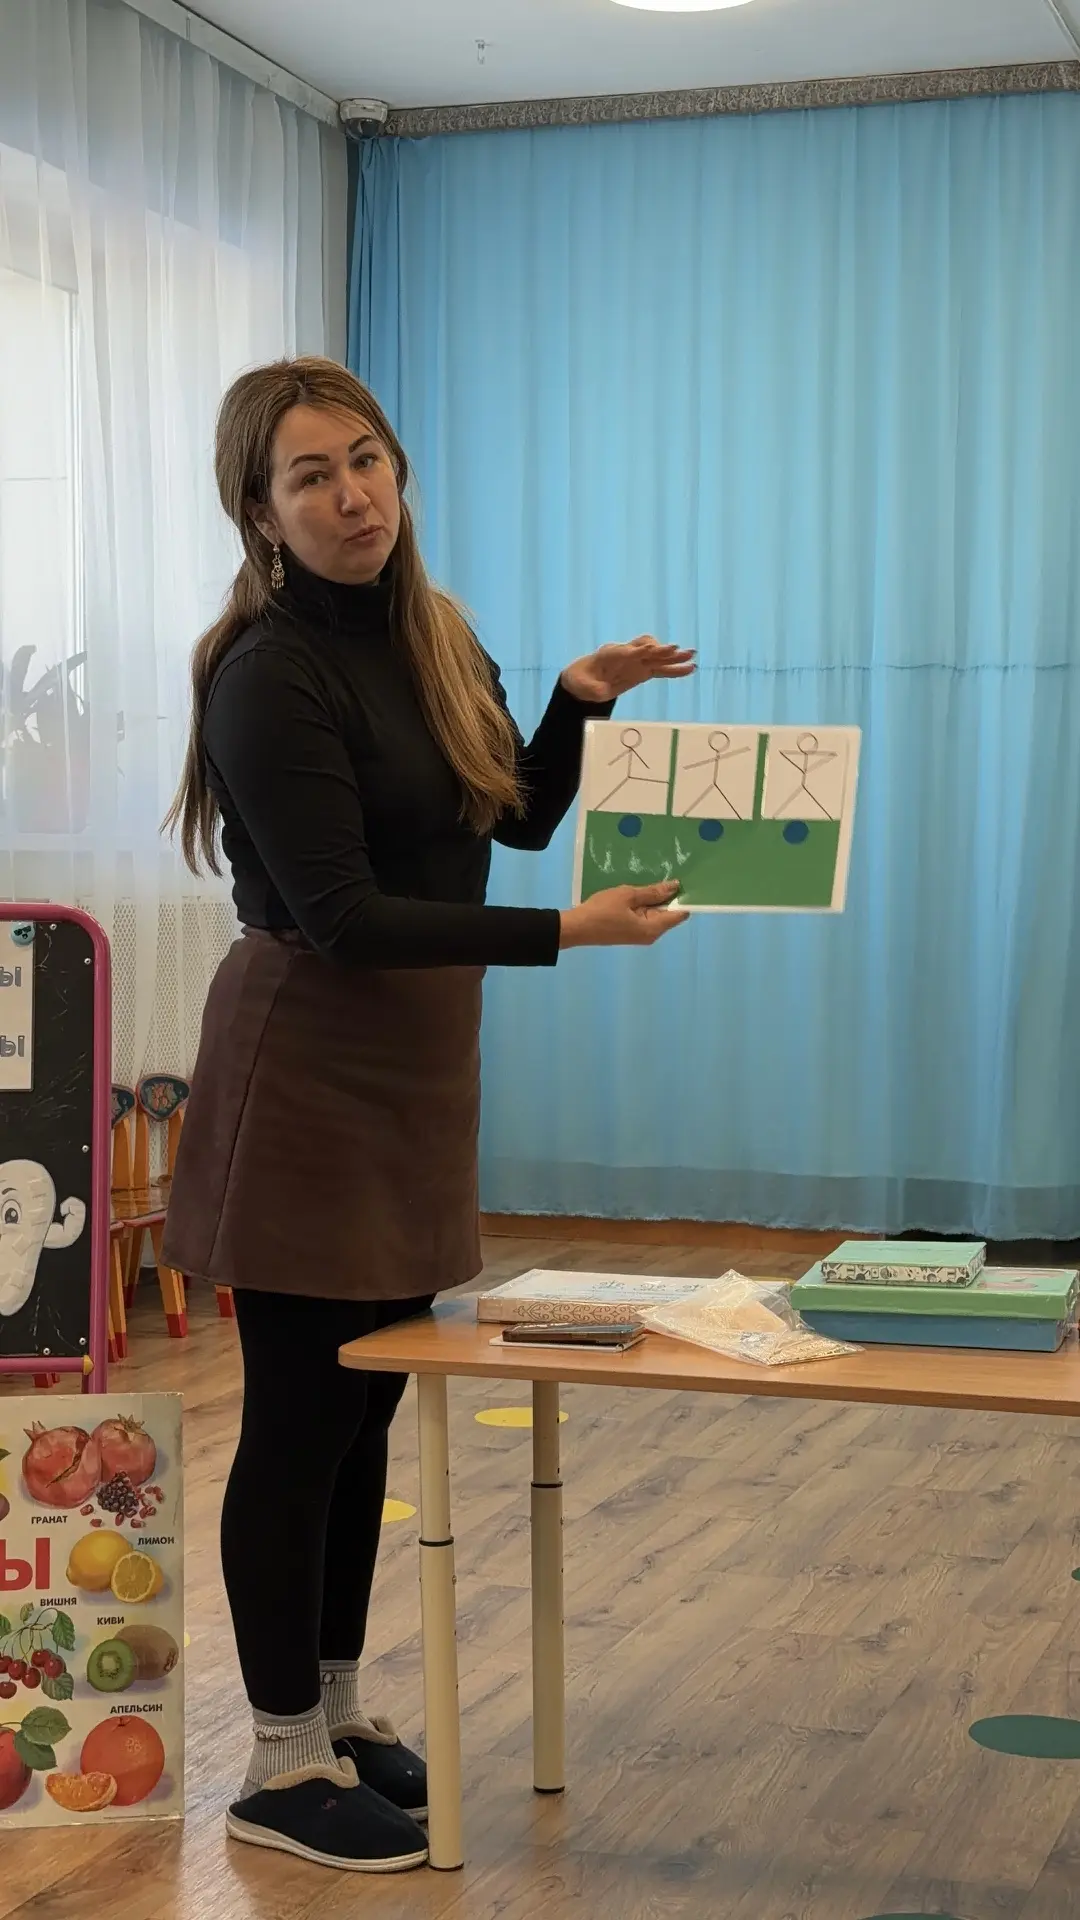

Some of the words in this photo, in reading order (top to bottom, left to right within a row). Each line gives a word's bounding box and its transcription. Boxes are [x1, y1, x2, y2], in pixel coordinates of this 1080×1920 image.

[31, 1515, 69, 1525] ГРАНАТ
[137, 1536, 175, 1546] ЛИМОН
[40, 1597, 77, 1607] ВИШНЯ
[97, 1616, 125, 1626] КИВИ
[110, 1703, 163, 1715] АПЕЛЬСИН
